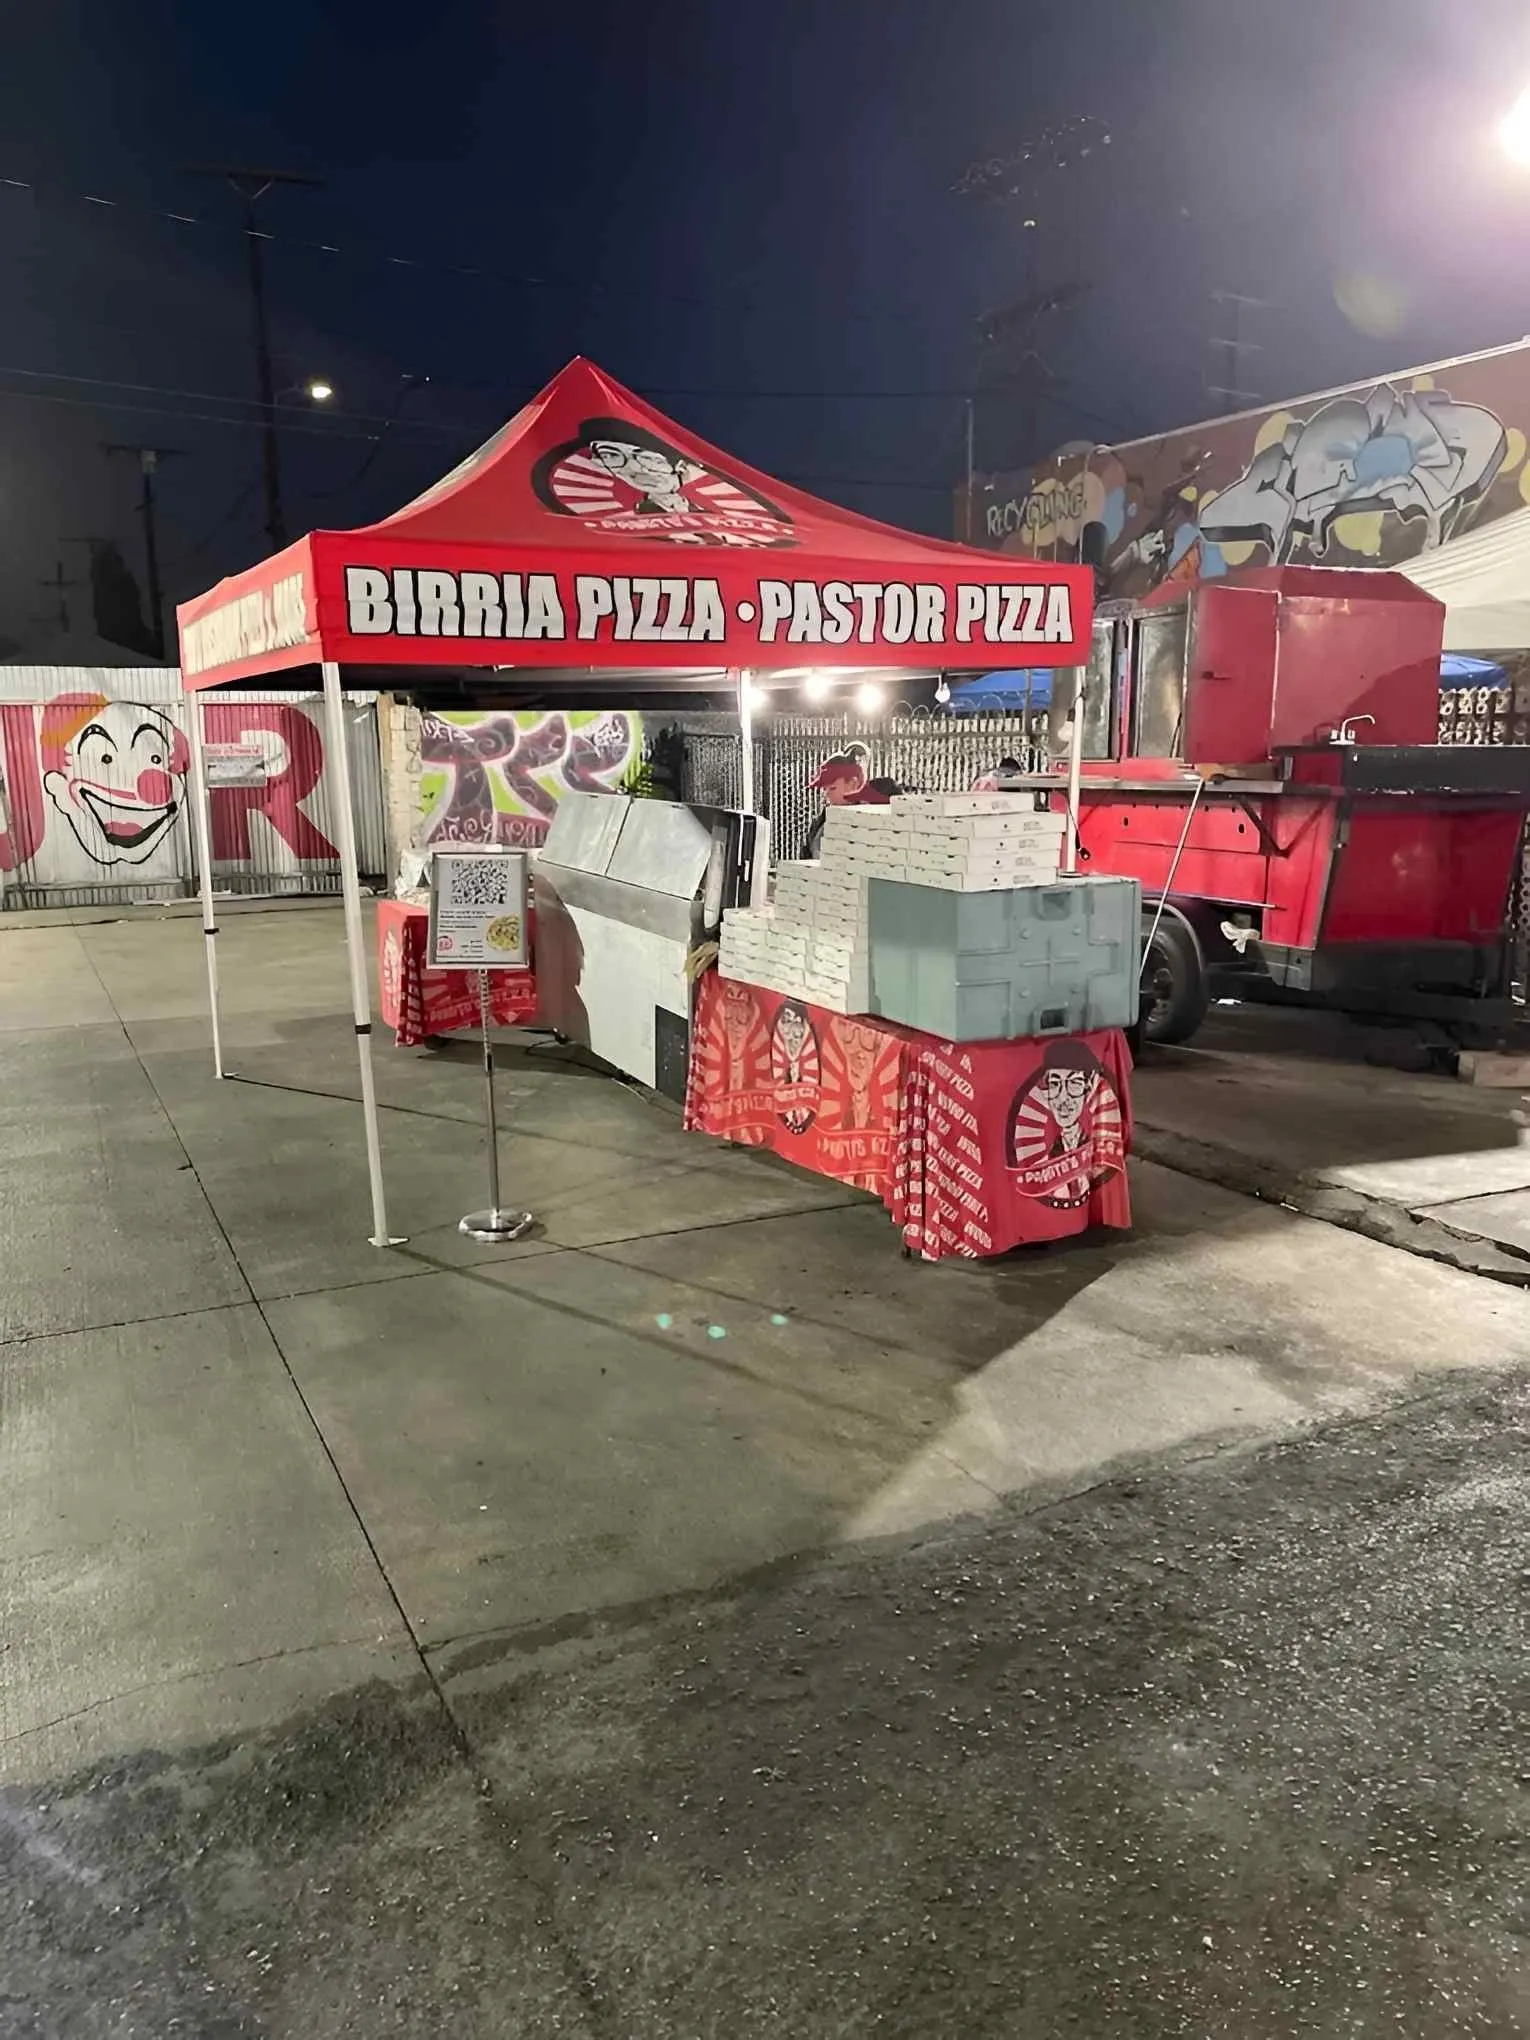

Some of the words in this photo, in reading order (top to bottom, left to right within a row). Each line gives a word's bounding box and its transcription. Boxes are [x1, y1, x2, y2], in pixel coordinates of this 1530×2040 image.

[344, 565, 566, 640] BIRRIA
[574, 574, 727, 642] PIZZA
[757, 579, 949, 644] PASTOR
[955, 583, 1075, 644] PIZZA
